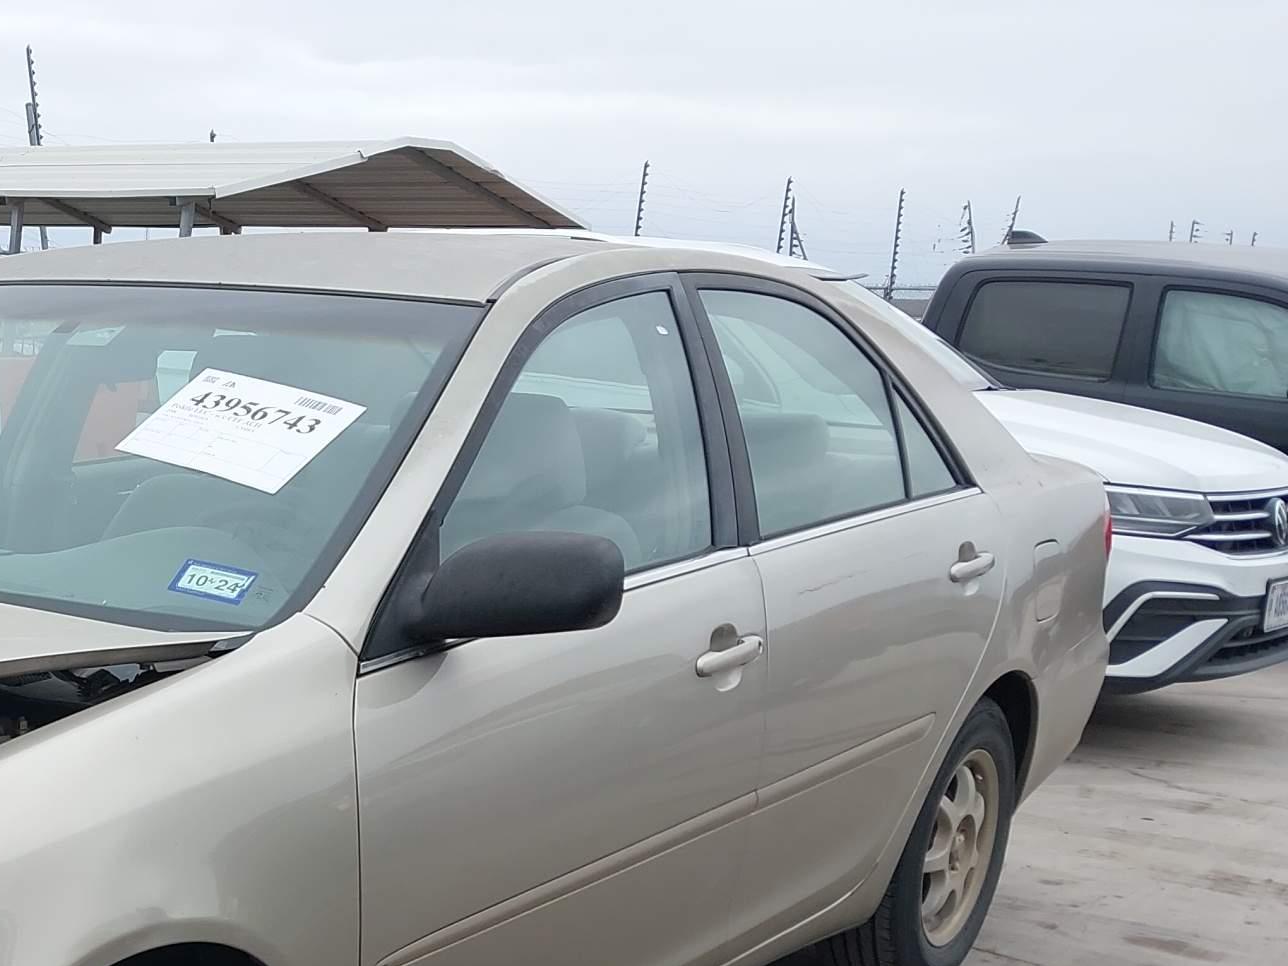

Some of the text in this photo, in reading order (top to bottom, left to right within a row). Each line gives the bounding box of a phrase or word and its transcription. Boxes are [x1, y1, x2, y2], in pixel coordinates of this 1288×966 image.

[190, 391, 321, 434] 43956743
[186, 573, 239, 593] 10 24
